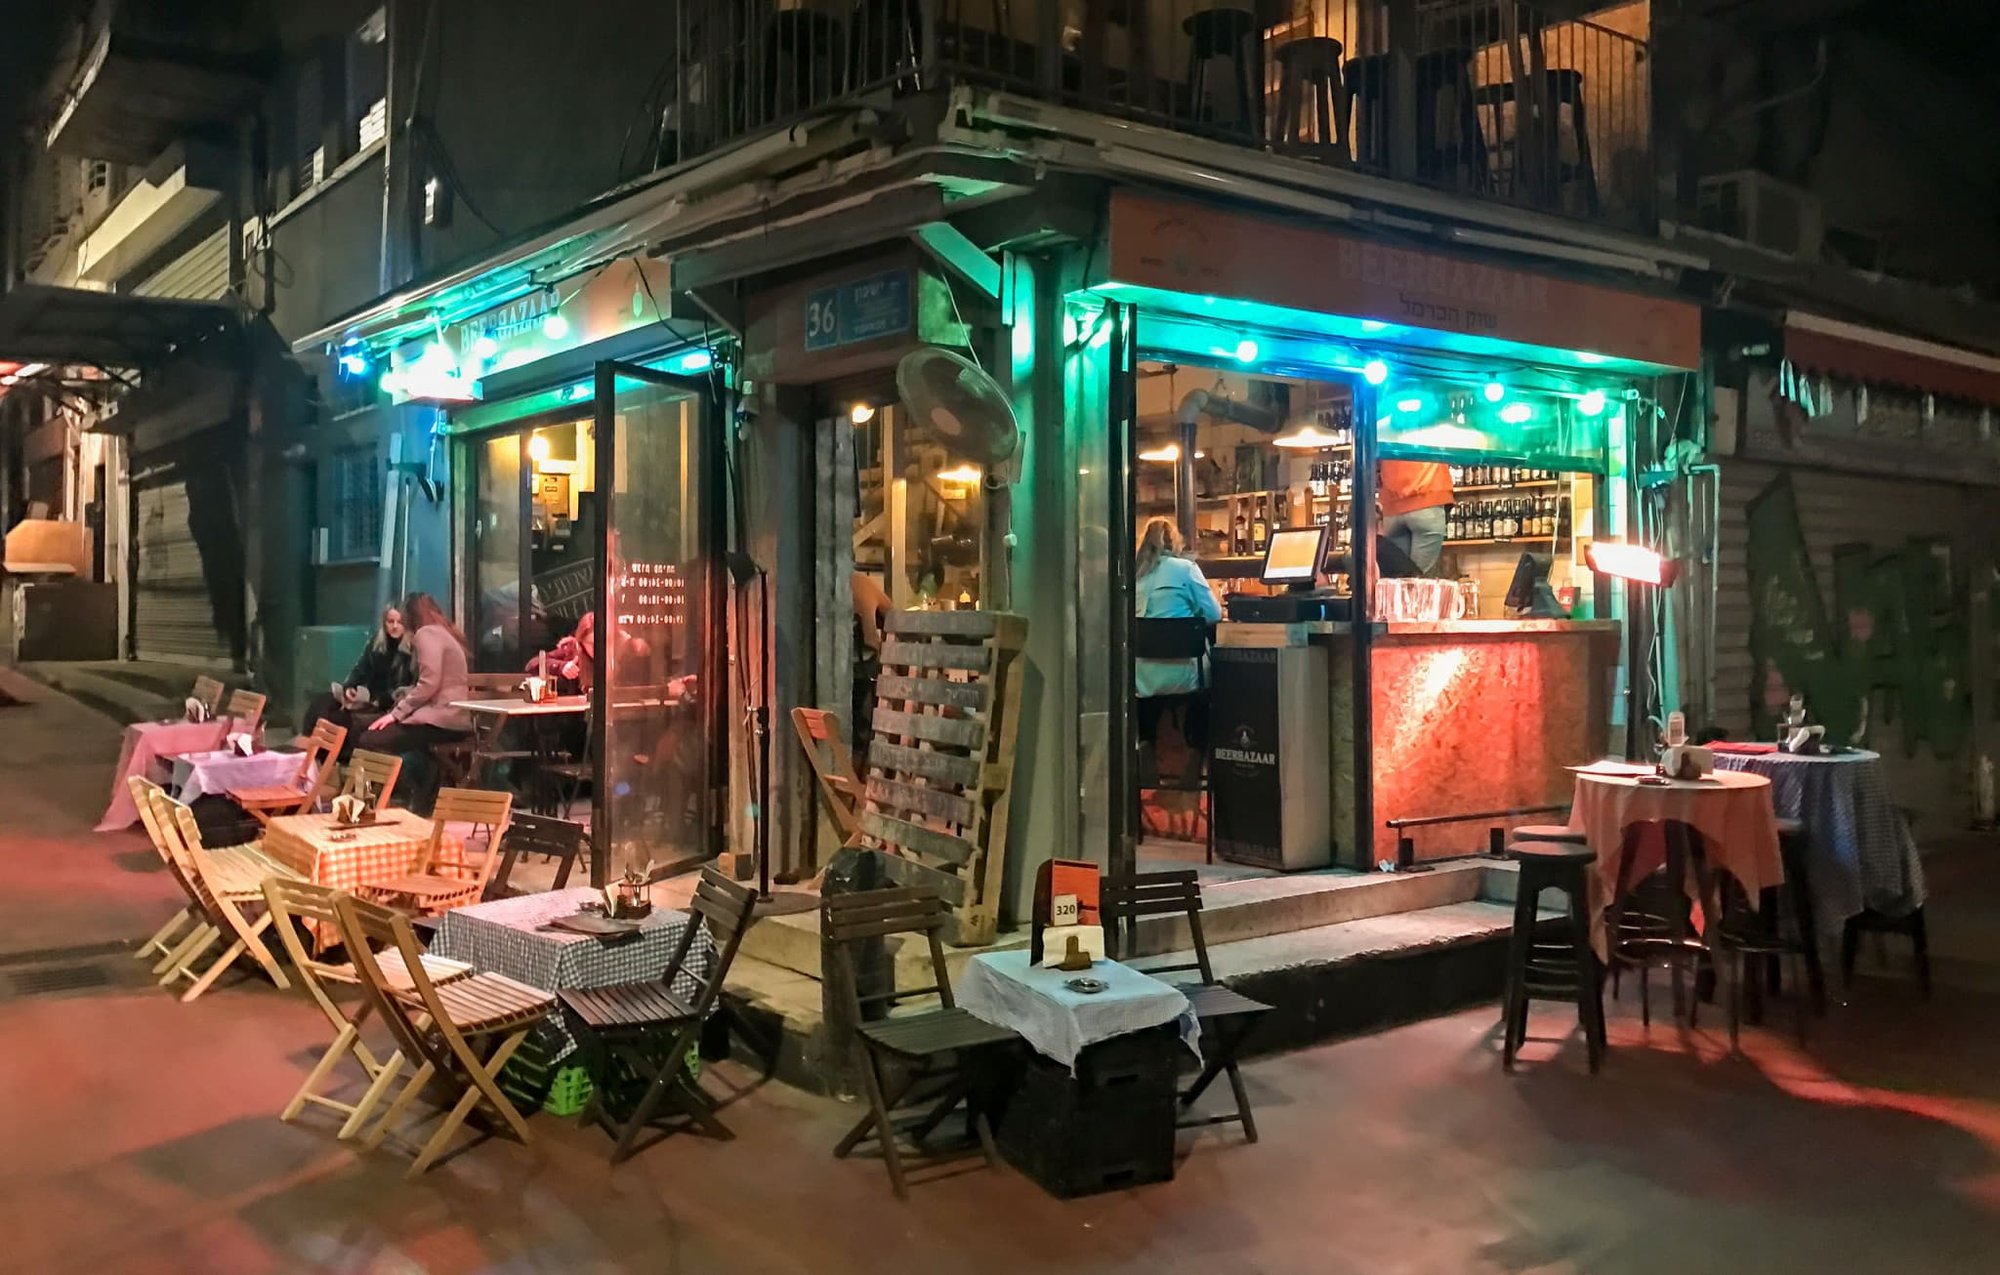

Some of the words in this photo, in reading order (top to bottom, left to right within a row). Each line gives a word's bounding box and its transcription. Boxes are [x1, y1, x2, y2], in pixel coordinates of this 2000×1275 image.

[1398, 290, 1460, 323] הכרמל
[808, 299, 836, 338] 36
[1466, 310, 1497, 330] שוק
[1215, 748, 1275, 765] BEERBAZAAR
[1056, 904, 1075, 915] 320
